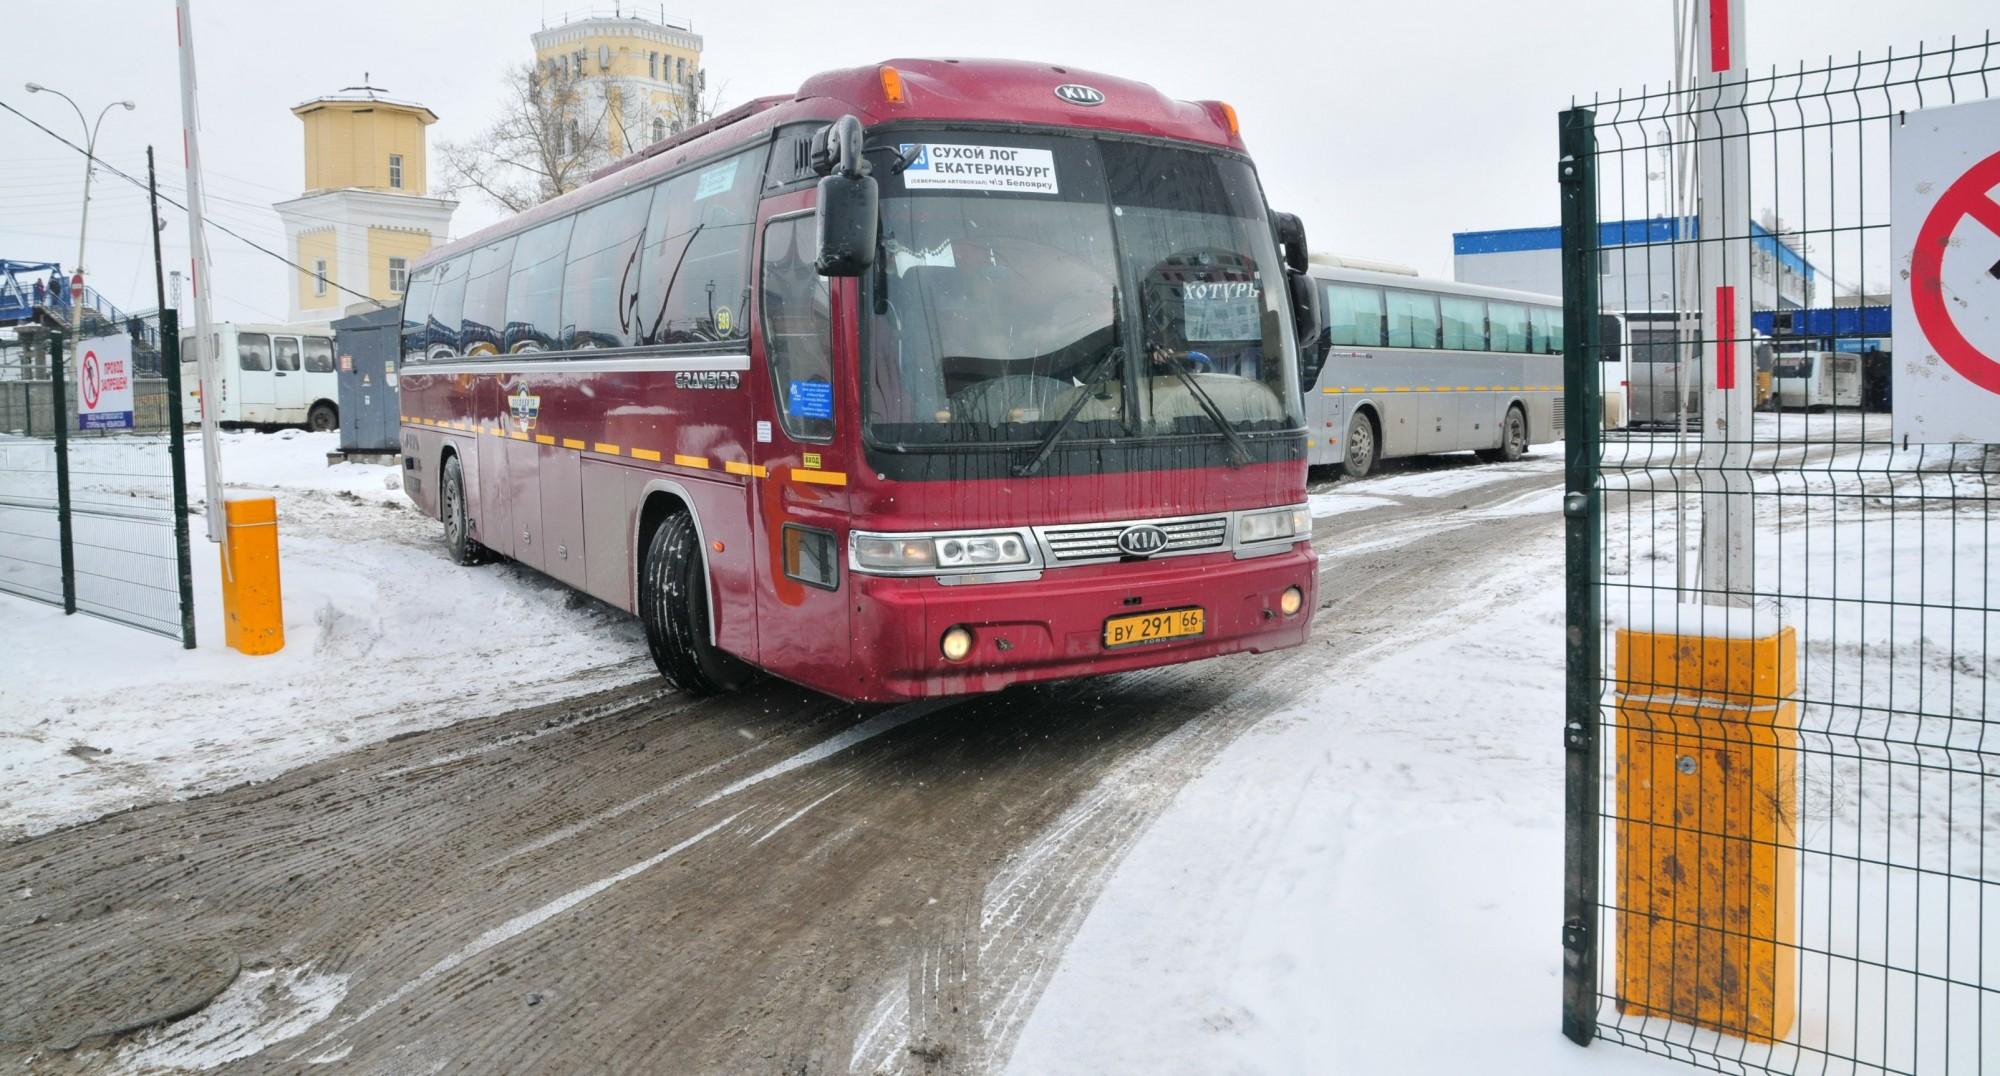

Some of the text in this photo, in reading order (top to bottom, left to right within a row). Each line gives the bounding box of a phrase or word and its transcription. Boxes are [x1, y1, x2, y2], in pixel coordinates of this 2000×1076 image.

[1062, 87, 1100, 100] KIA
[932, 146, 984, 161] СУХОЙ
[990, 150, 1018, 161] ЛОГ
[935, 162, 1050, 178] ЕКАТЕРИНБУРГ
[1006, 178, 1053, 190] Белоярку
[675, 371, 740, 389] GRANBIRD
[1127, 532, 1162, 549] KIA
[1114, 611, 1198, 641] ВУ 291 66
